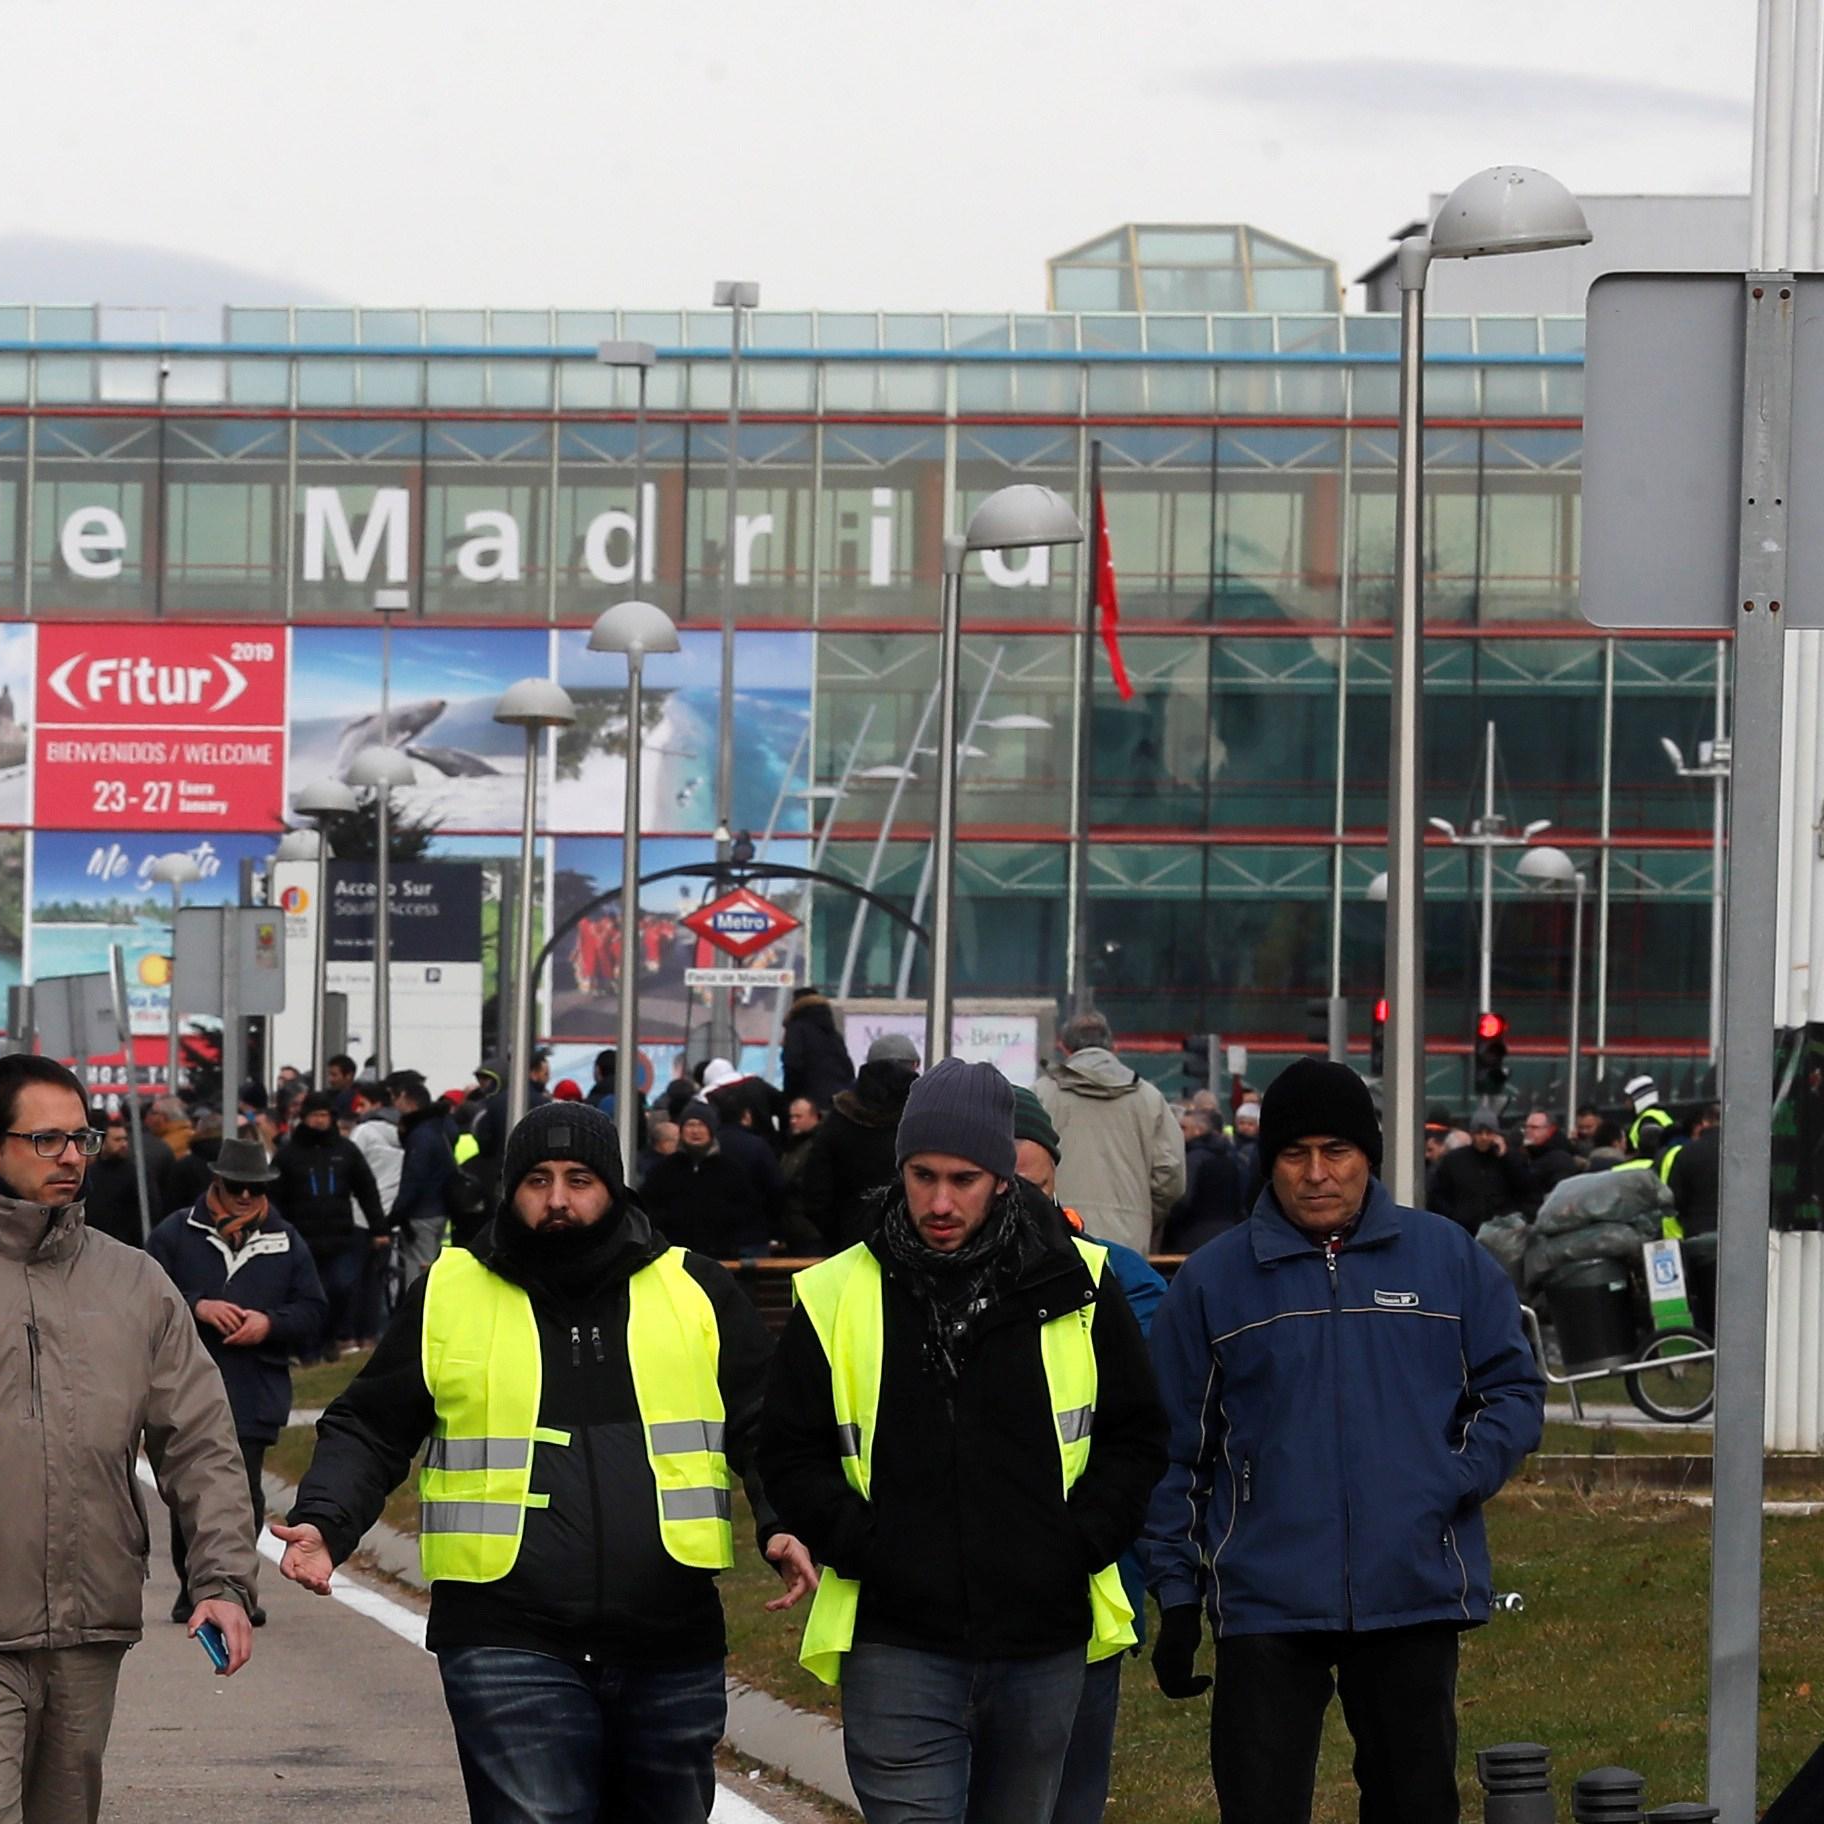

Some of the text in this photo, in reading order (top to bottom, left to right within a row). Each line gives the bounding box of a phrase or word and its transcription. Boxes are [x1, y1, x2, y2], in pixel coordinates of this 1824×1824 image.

[86, 642, 274, 705] Fitur 2019
[46, 742, 168, 764] BIENVENIDOS
[182, 743, 273, 766] WELCOME
[134, 841, 221, 892] gta
[335, 879, 434, 896] Acceo Sur
[716, 913, 765, 930] Metro
